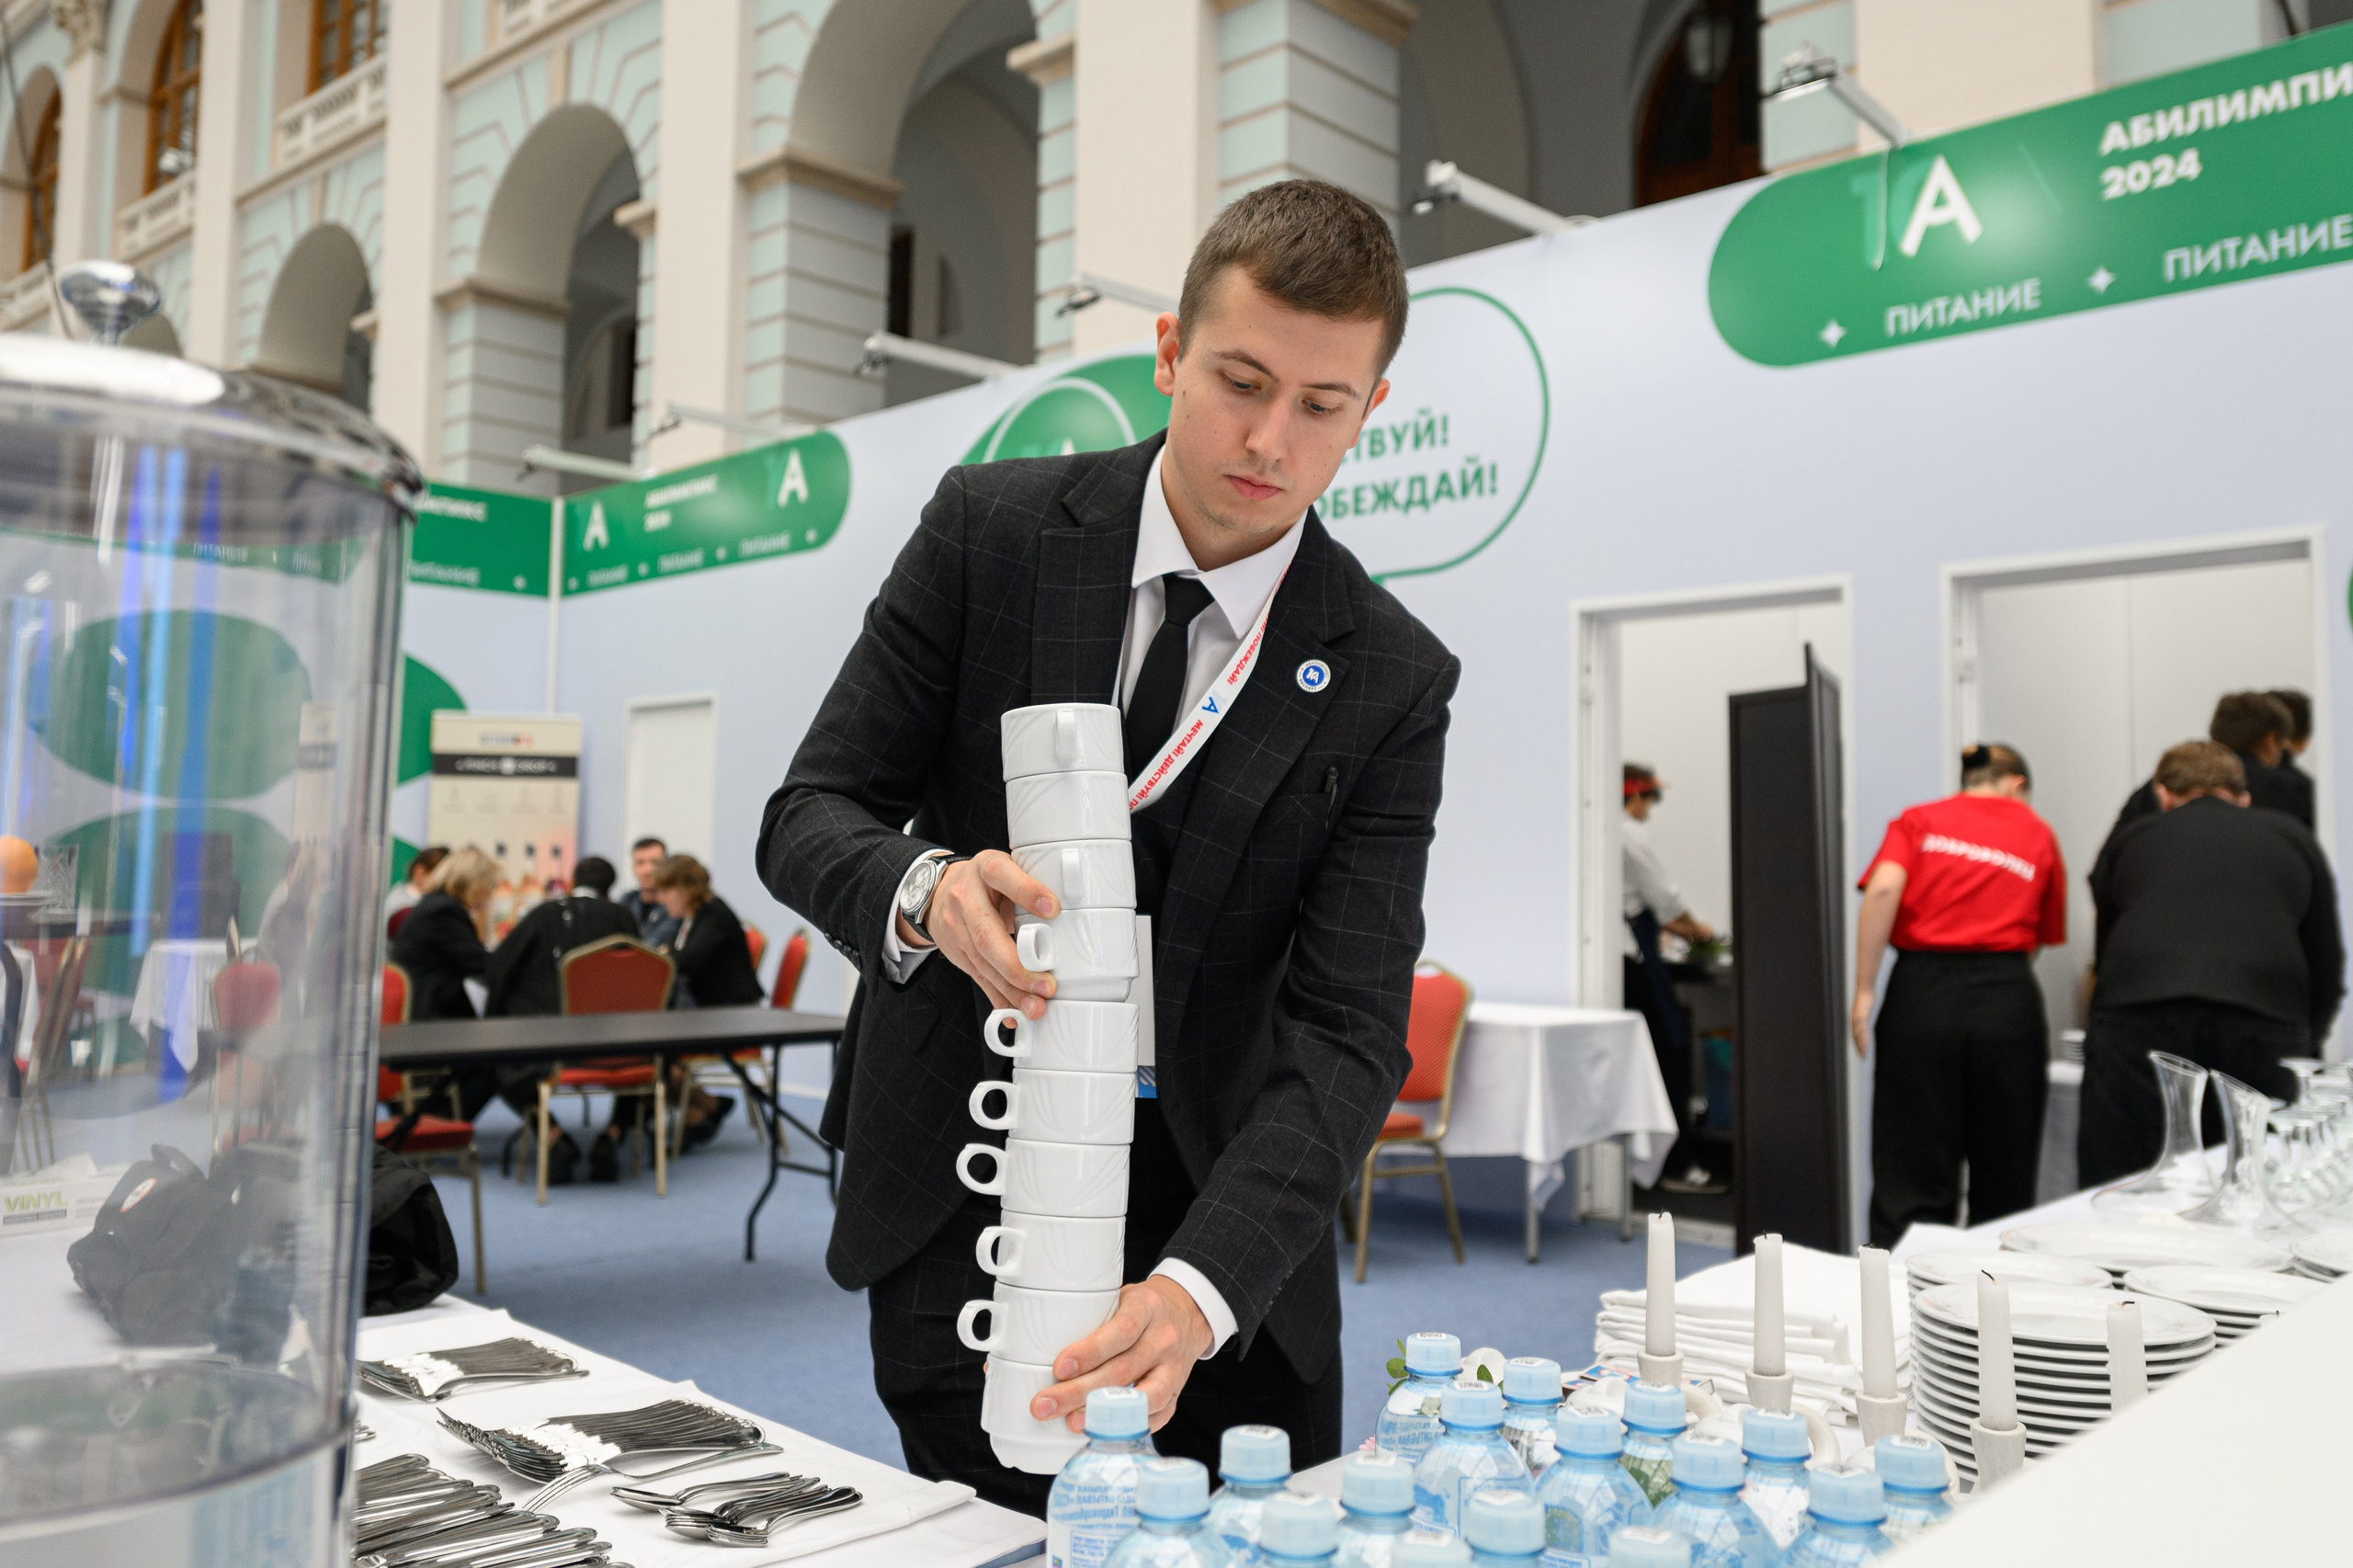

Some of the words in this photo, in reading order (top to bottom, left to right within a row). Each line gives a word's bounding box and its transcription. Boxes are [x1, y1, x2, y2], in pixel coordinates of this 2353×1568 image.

[2098, 61, 2353, 156] АБИЛИМПИ
[2099, 147, 2202, 200] 2024
[1885, 277, 2042, 338] ПИТАНИЕ
[2164, 212, 2353, 283] ПИТАНИЕ
[1342, 407, 1449, 465] ТВУЙ!
[1226, 630, 1263, 686] ПОБЕЖДАЙ!
[1172, 719, 1204, 756] МЕЧТАЙ!
[1136, 754, 1176, 801] ДЕЙСТВУЙ!
[4, 1191, 67, 1212] VINYL
